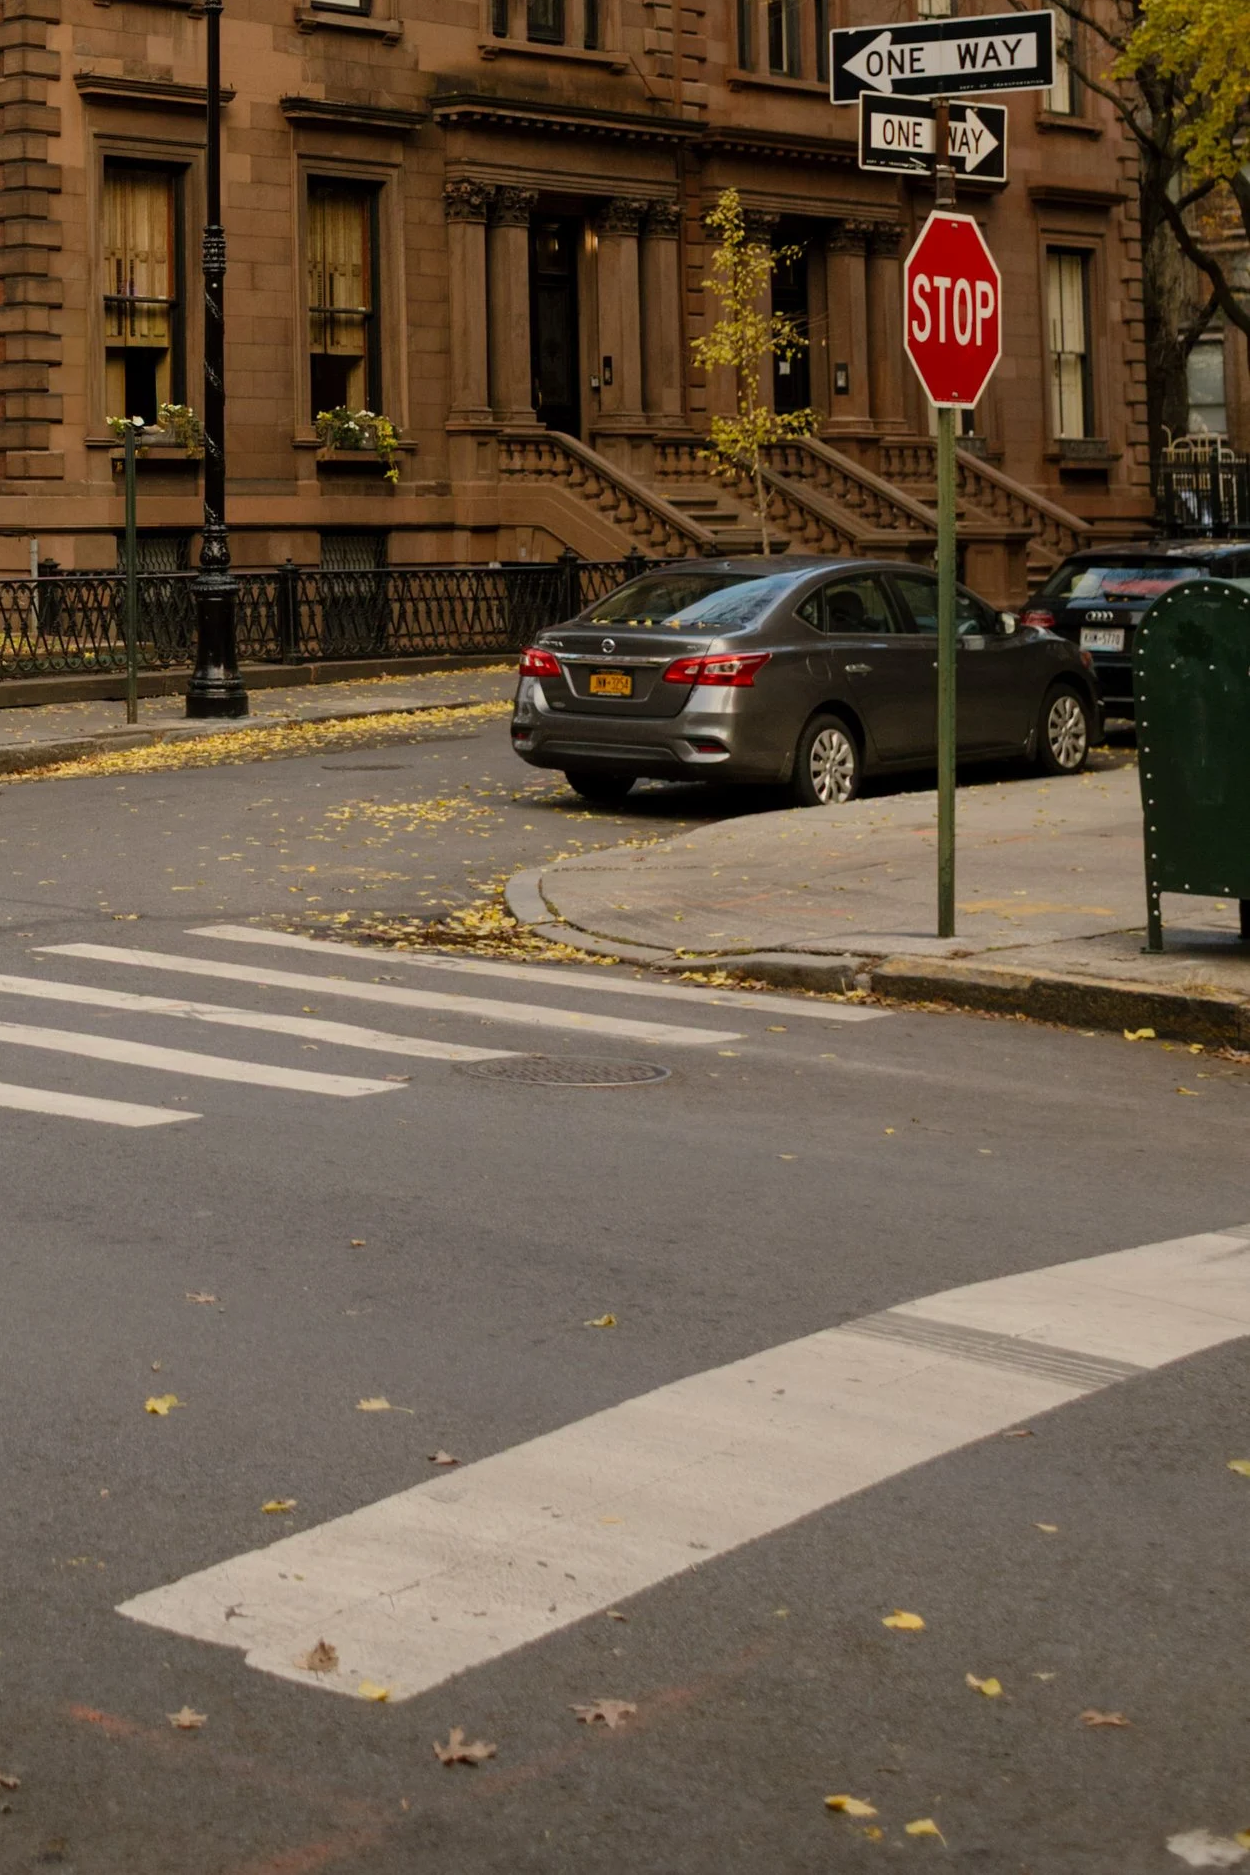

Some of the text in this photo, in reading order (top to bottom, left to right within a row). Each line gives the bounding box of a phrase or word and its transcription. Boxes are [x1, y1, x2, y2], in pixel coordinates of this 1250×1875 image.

[866, 38, 1022, 77] ONE WAY
[882, 118, 923, 149] ONE
[911, 273, 995, 347] STOP
